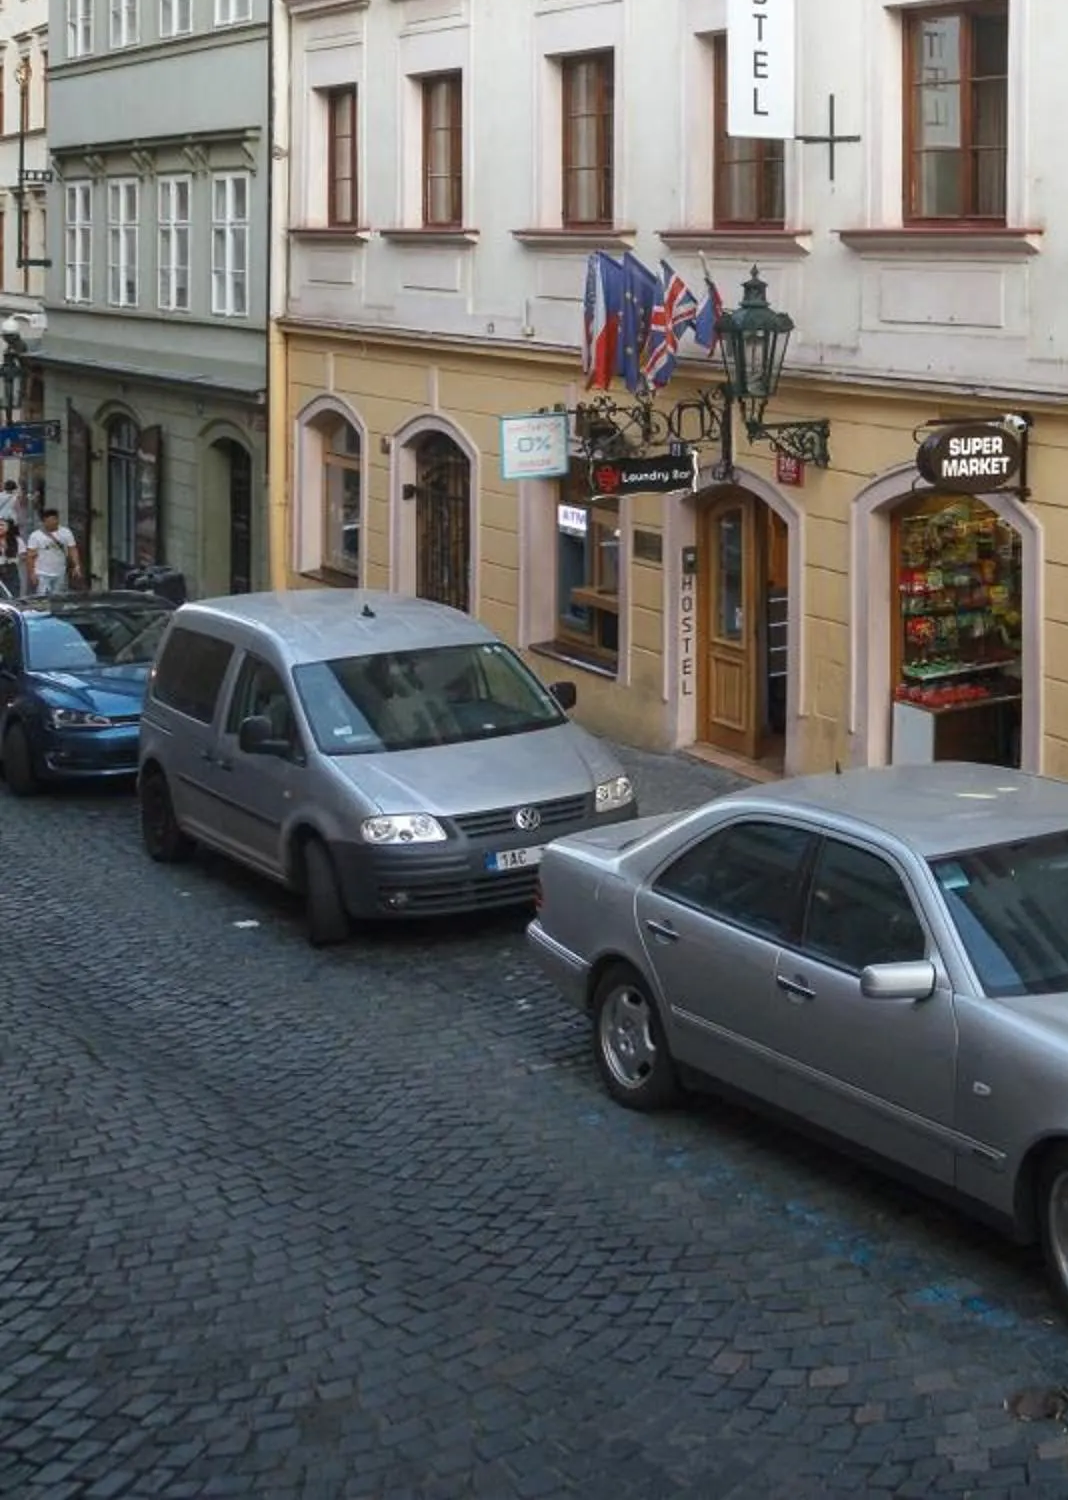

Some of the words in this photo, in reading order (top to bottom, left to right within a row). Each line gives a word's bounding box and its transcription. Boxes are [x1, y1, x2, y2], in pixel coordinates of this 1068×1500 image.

[948, 435, 1004, 457] SUPER
[621, 469, 670, 484] Laundry
[671, 468, 691, 480] Bar
[941, 456, 1011, 478] MARKET
[681, 575, 693, 696] HOSTEL
